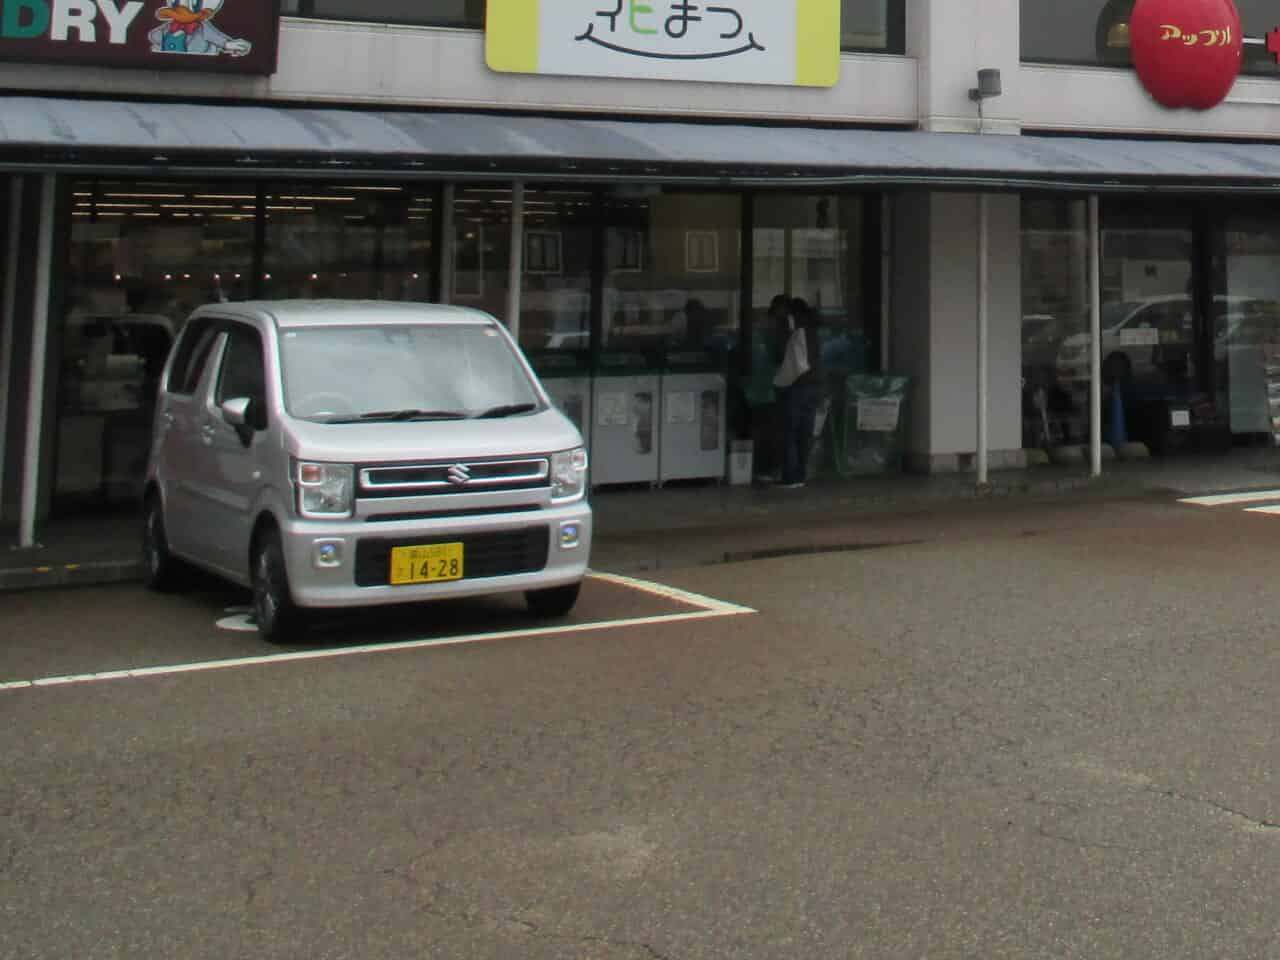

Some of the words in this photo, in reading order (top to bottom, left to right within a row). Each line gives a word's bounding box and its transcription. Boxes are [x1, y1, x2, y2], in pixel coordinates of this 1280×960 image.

[1159, 24, 1233, 47] アップル
[410, 558, 459, 580] 14-28
